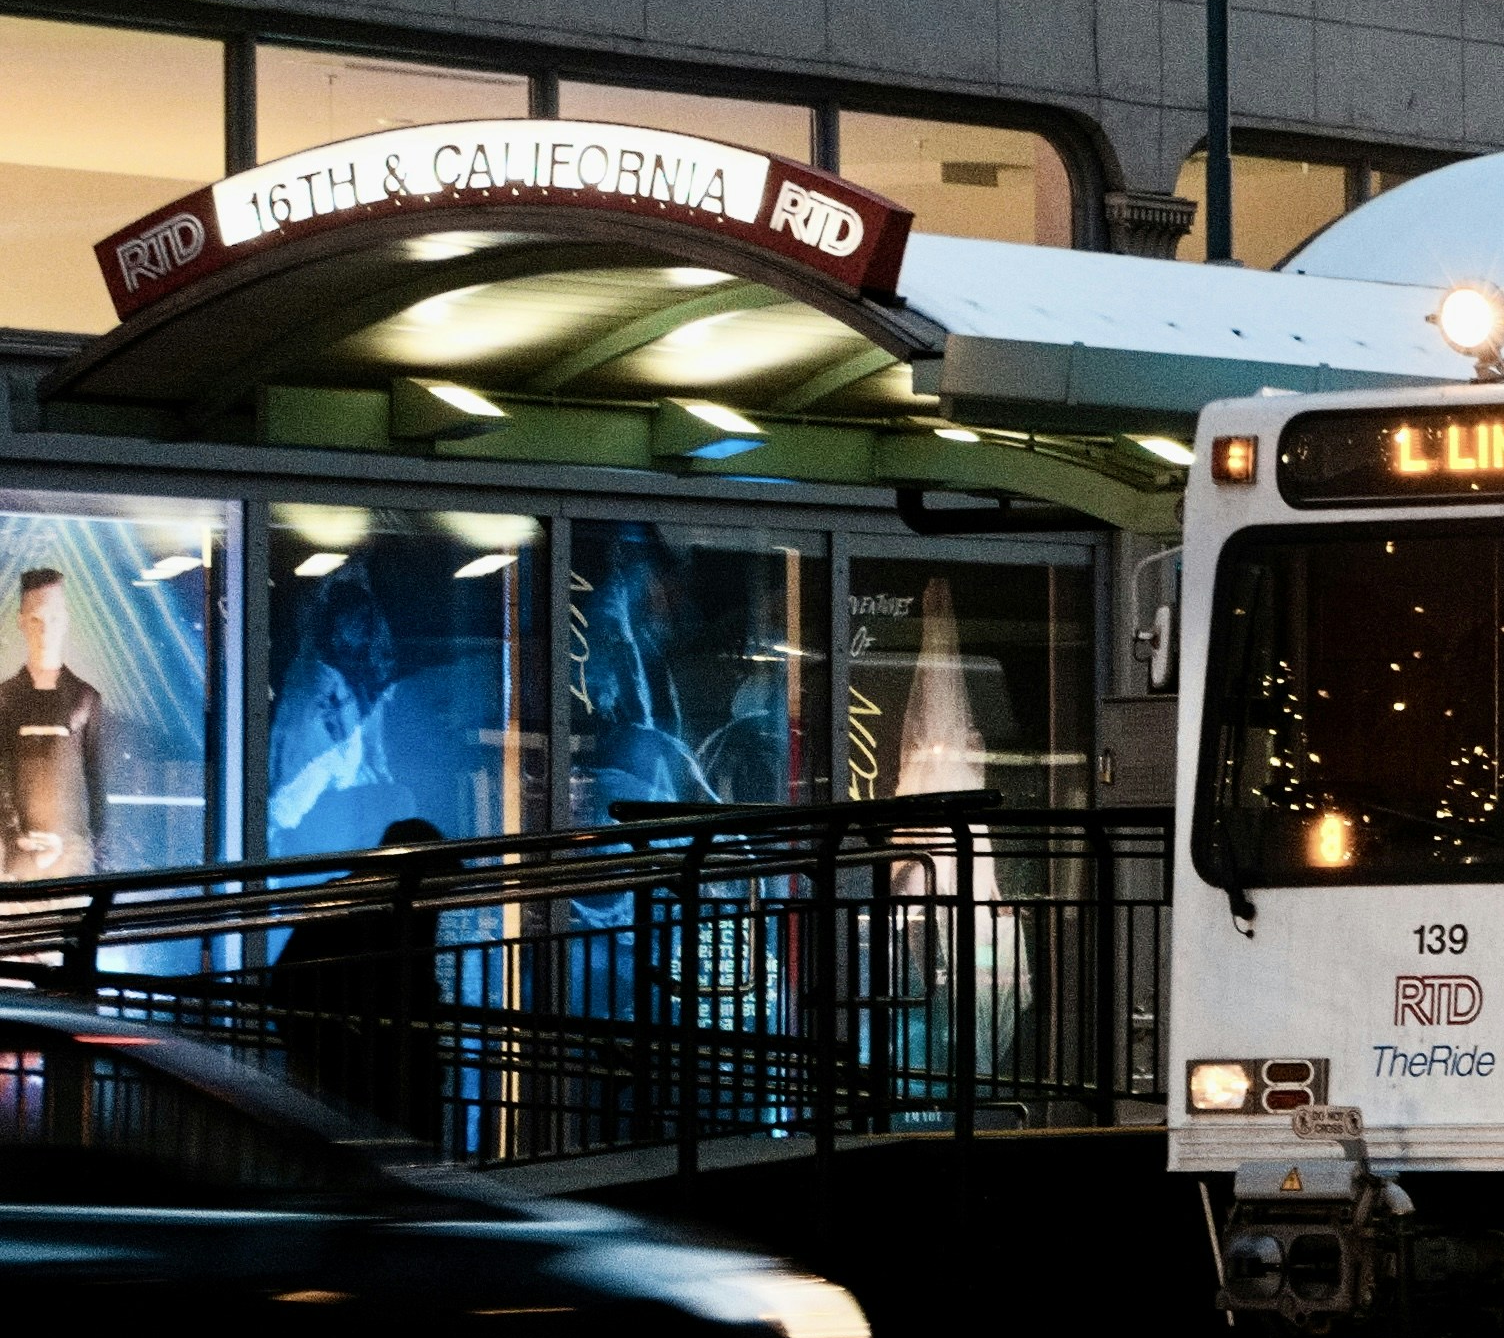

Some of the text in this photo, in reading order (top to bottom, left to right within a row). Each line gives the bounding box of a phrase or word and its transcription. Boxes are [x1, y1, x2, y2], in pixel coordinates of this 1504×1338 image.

[114, 141, 865, 294] RTD 16TH & CALIFORNIA RTD
[1395, 425, 1429, 472] L
[1411, 924, 1469, 957] 139
[1393, 974, 1483, 1027] RTD
[1371, 1045, 1496, 1079] TheRide
